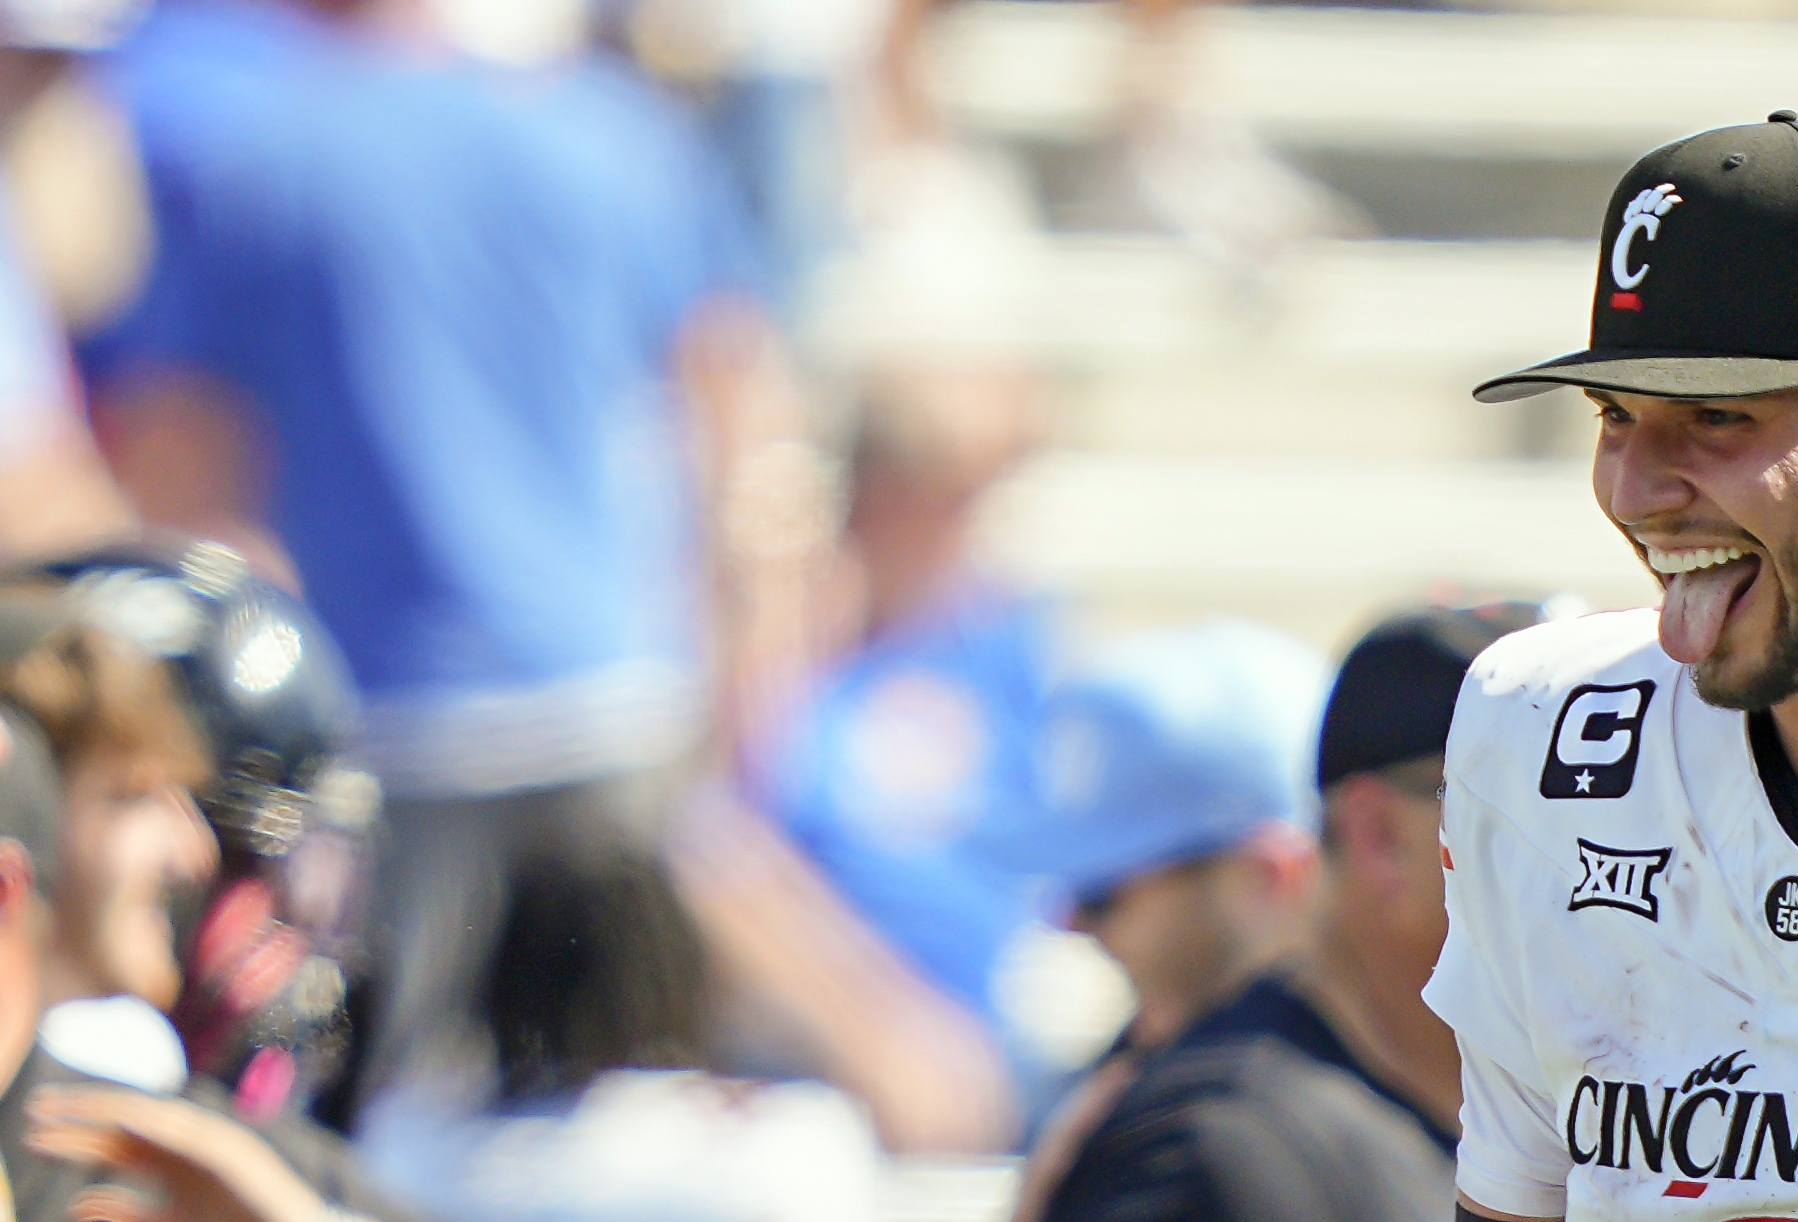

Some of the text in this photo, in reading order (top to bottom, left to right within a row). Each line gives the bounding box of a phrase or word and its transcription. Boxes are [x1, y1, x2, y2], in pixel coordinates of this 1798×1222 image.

[1611, 205, 1664, 291] C
[1556, 688, 1642, 767] C
[1571, 843, 1664, 914] XII
